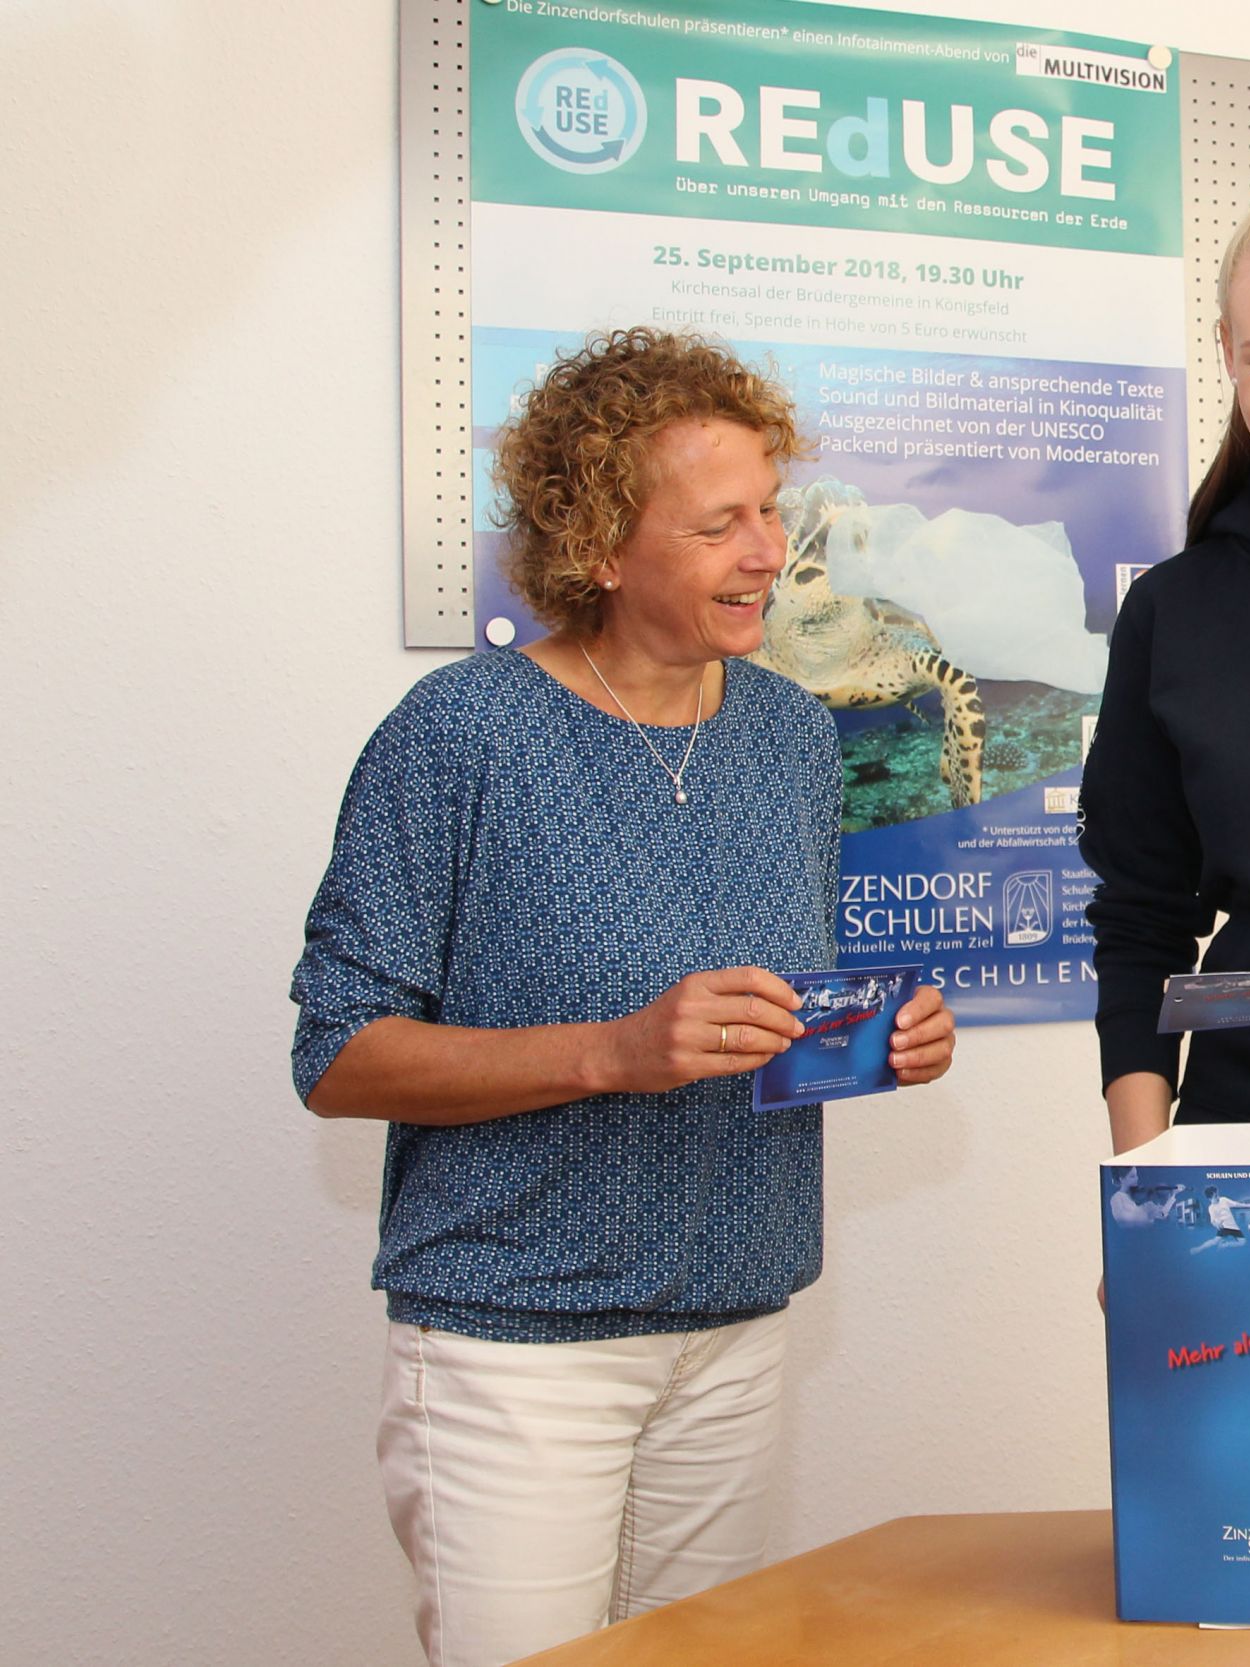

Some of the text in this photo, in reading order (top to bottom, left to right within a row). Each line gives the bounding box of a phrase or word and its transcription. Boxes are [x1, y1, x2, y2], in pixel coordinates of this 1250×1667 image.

[507, 0, 533, 14] Die
[537, 1, 680, 31] Zinzendorfschulen
[793, 29, 833, 45] einen
[837, 33, 981, 63] Infotainment-Abend
[984, 48, 1010, 63] von
[1016, 45, 1038, 59] die
[1044, 58, 1165, 91] MULTIVISION
[555, 85, 609, 111] REd
[556, 111, 609, 136] USE
[676, 77, 1116, 200] REdUSE
[676, 177, 1129, 231] über unseren Umgang mit den Ressourcen der Erde
[653, 245, 1025, 290] 25. September 2018, 19.30 Uhr
[671, 280, 1010, 317] Kirchensaal der Brüdergemeine in Königsfeld
[652, 306, 1028, 344] Eintritt frei, Spende in Höhe von 5 Euro erwünscht
[819, 362, 1165, 399] Magische Bilder & ansprechende Texte
[819, 387, 1163, 424] Sound und Bildmaterial in Kinoqualität
[819, 411, 1104, 441] Ausgezeichnet von der UNESCO
[819, 436, 1160, 467] Packend präsentiert von Moderatoren
[957, 838, 977, 850] und
[978, 838, 995, 849] der
[996, 836, 1067, 849] Abfallwirtschaft
[990, 824, 1042, 836] Unterstützt
[1043, 826, 1060, 836] von
[844, 905, 994, 938] SCHULEN
[1062, 917, 1079, 929] der
[900, 939, 931, 955] Weg
[935, 939, 963, 951] zum
[968, 936, 994, 949] Ziel
[1206, 1172, 1233, 1180] SCHULEN
[1167, 1343, 1225, 1371] Mehr
